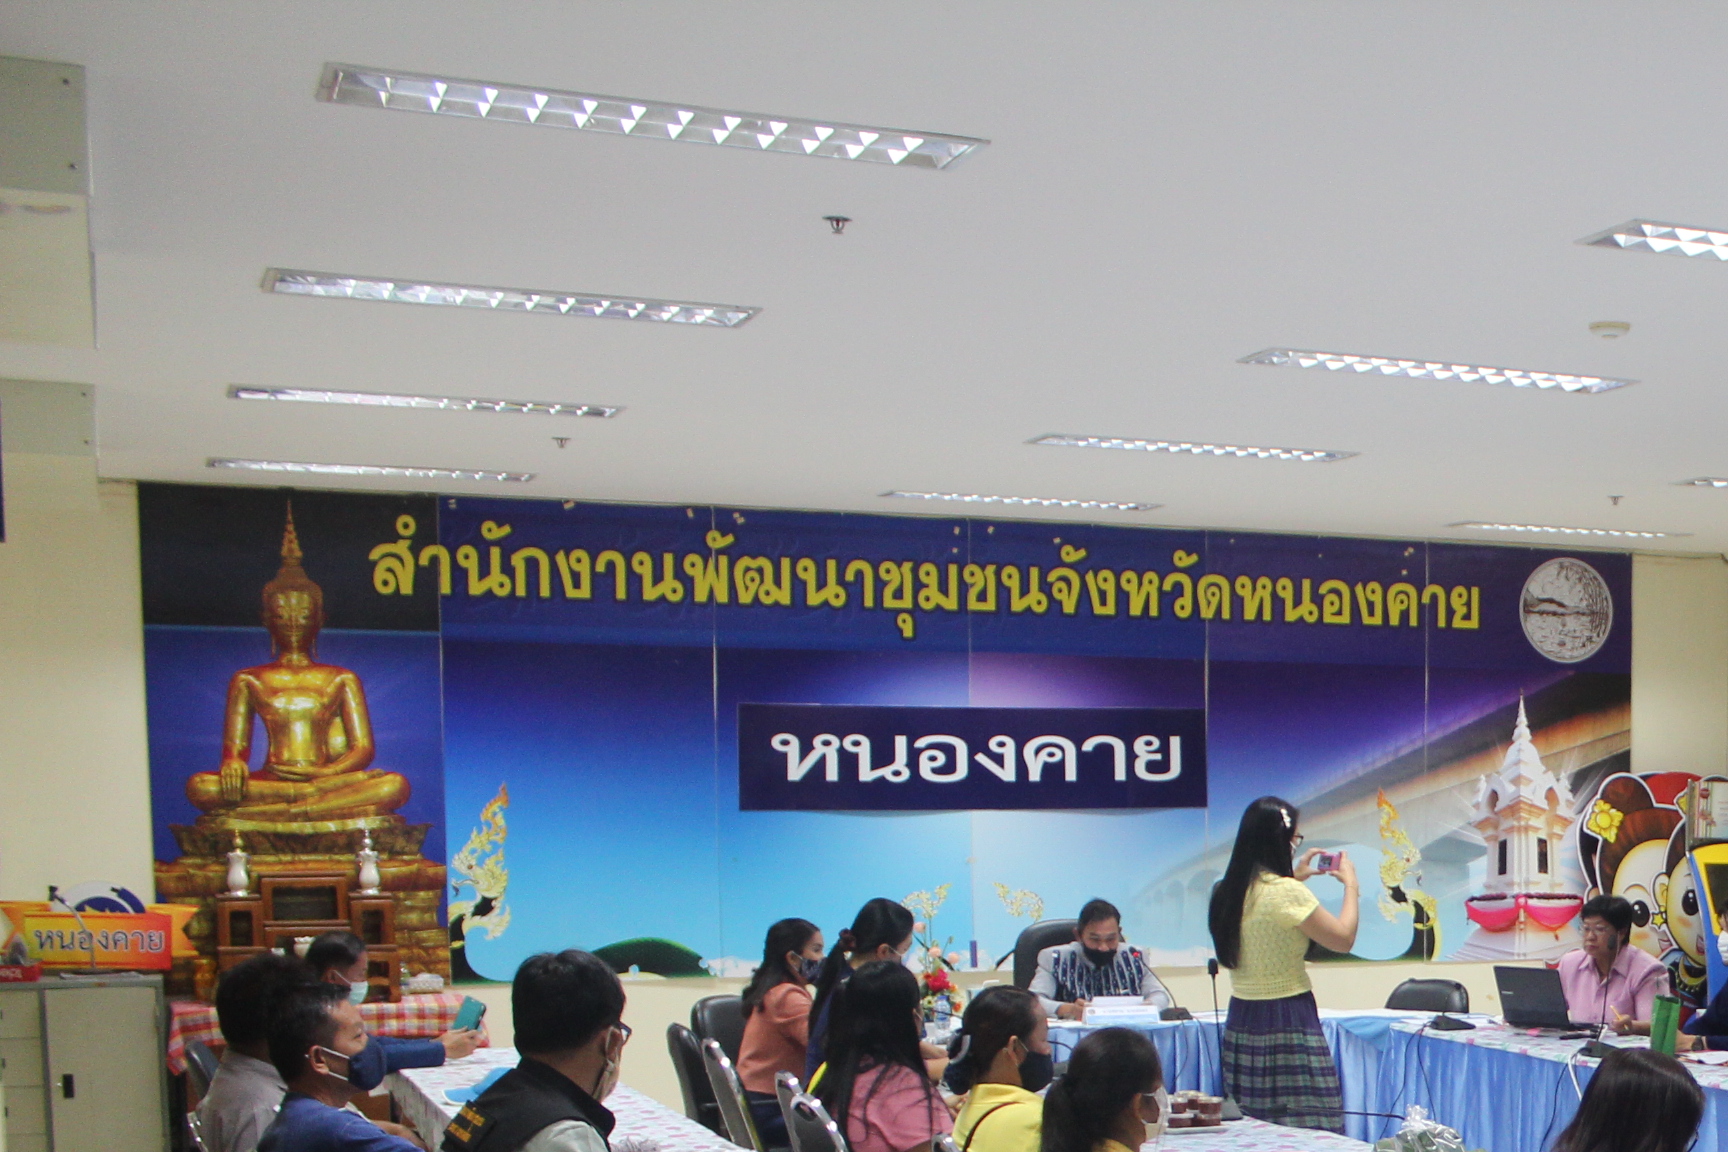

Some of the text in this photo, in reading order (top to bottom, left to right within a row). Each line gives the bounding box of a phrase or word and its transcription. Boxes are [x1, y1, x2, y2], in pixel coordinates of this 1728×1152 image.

[368, 514, 1481, 638] สำนักงานพัฒนาชุมชนจังหวัดหนองคาย
[771, 731, 1182, 783] หนองคาย
[34, 928, 164, 953] หนองคาย
